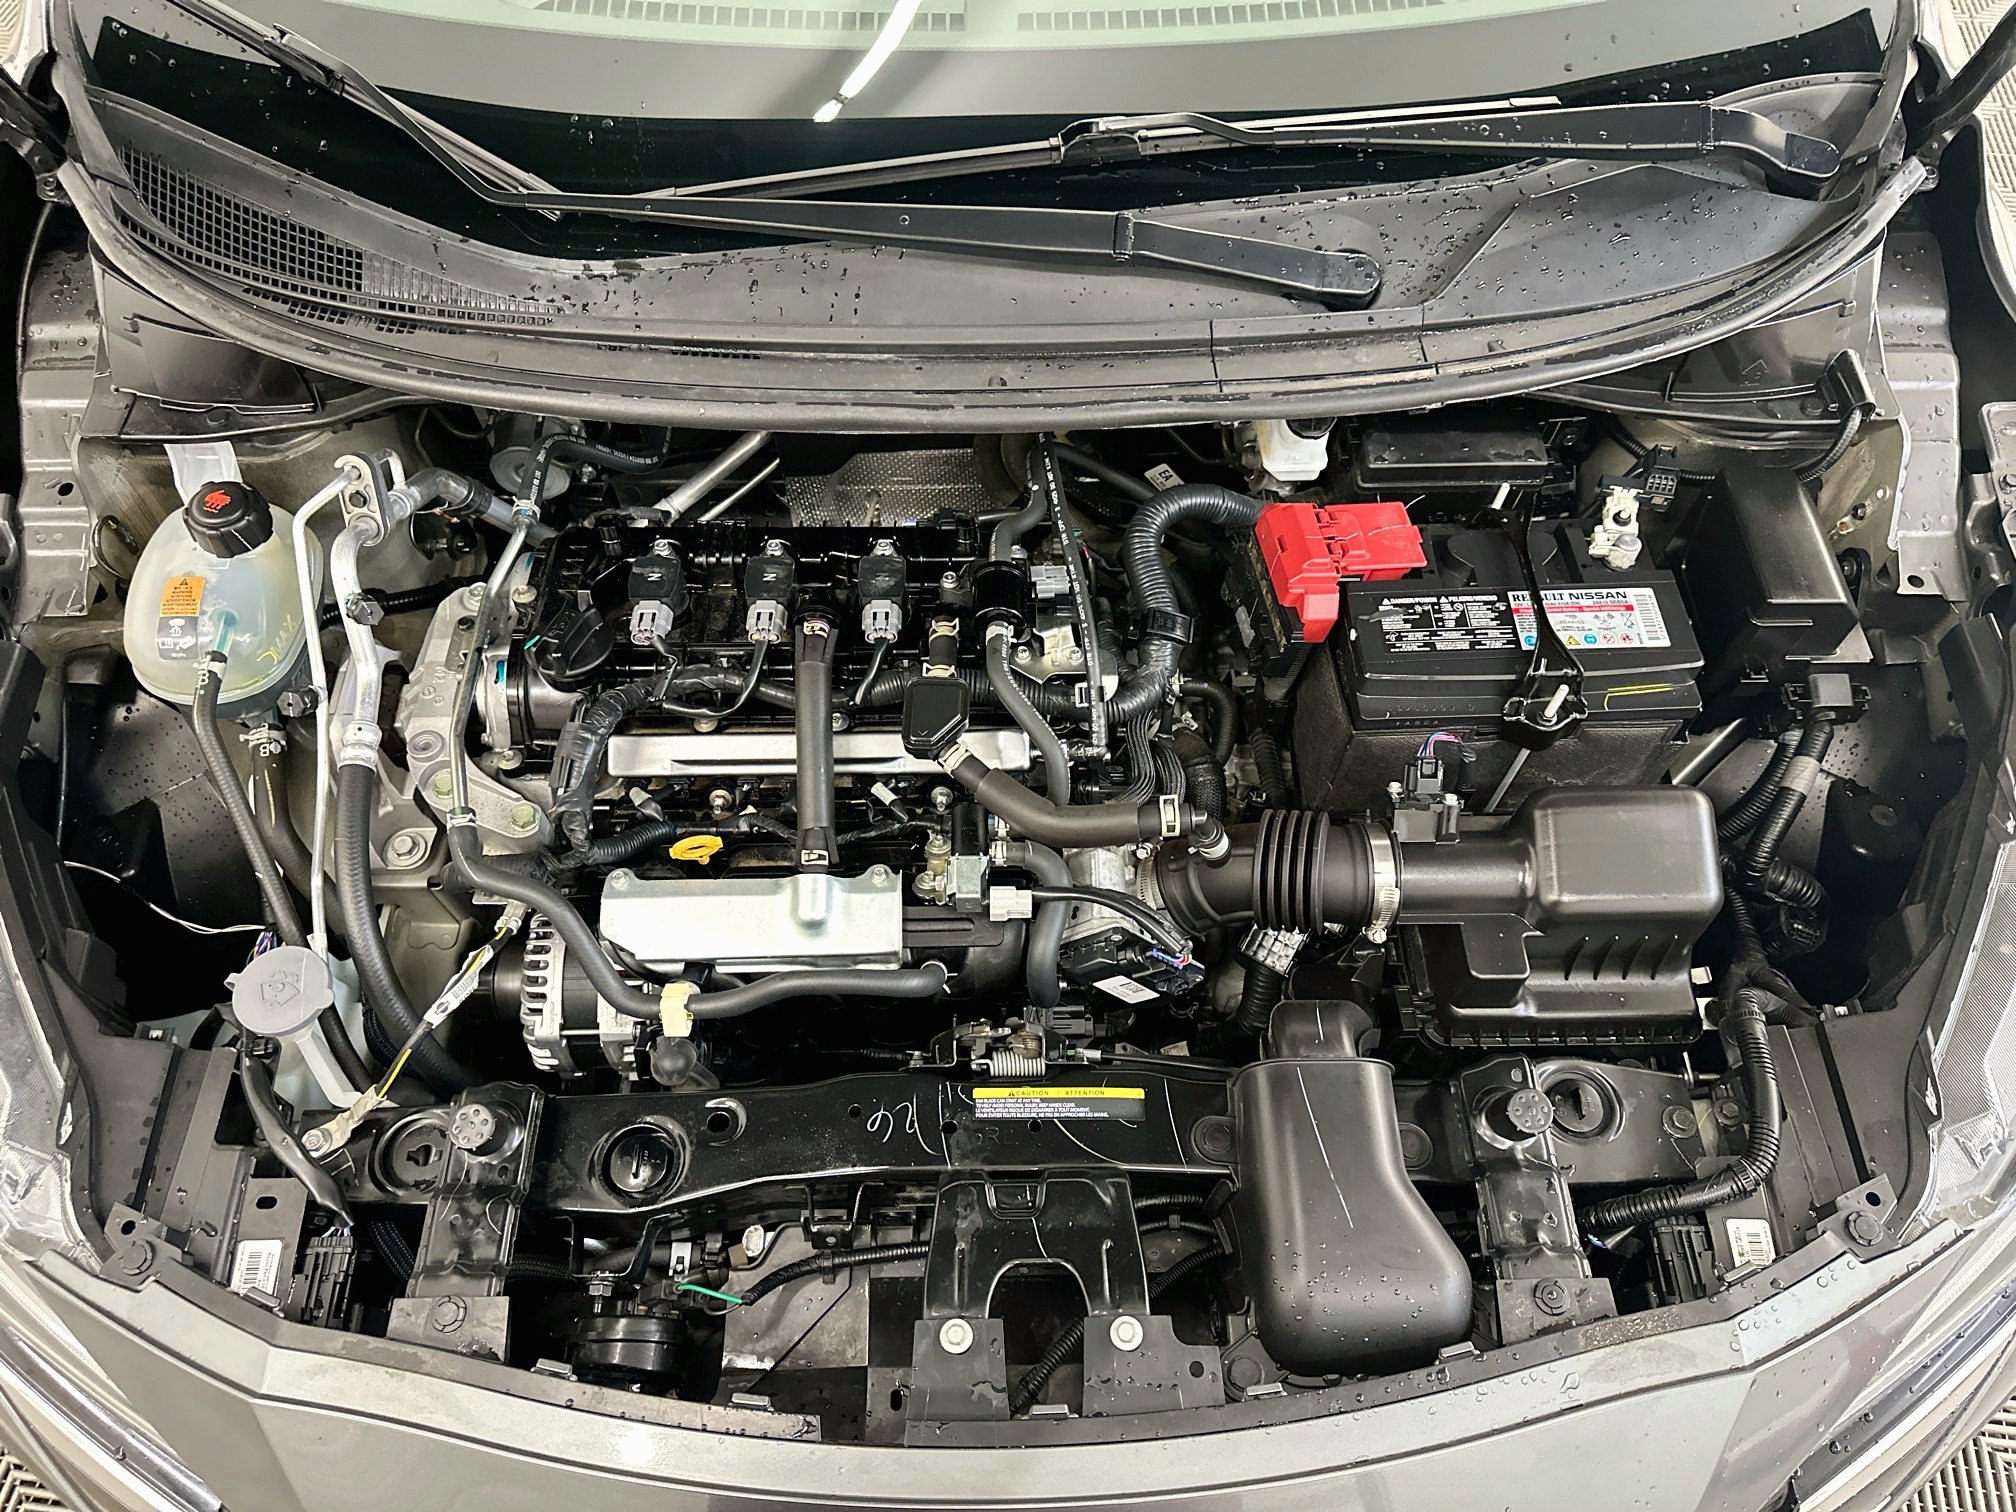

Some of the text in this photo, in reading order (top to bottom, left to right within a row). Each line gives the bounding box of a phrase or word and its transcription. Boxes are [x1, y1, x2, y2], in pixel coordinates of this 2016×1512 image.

[1158, 469, 1174, 482] EA
[1512, 591, 1627, 602] REULT NISSAN
[275, 614, 297, 652] MAX
